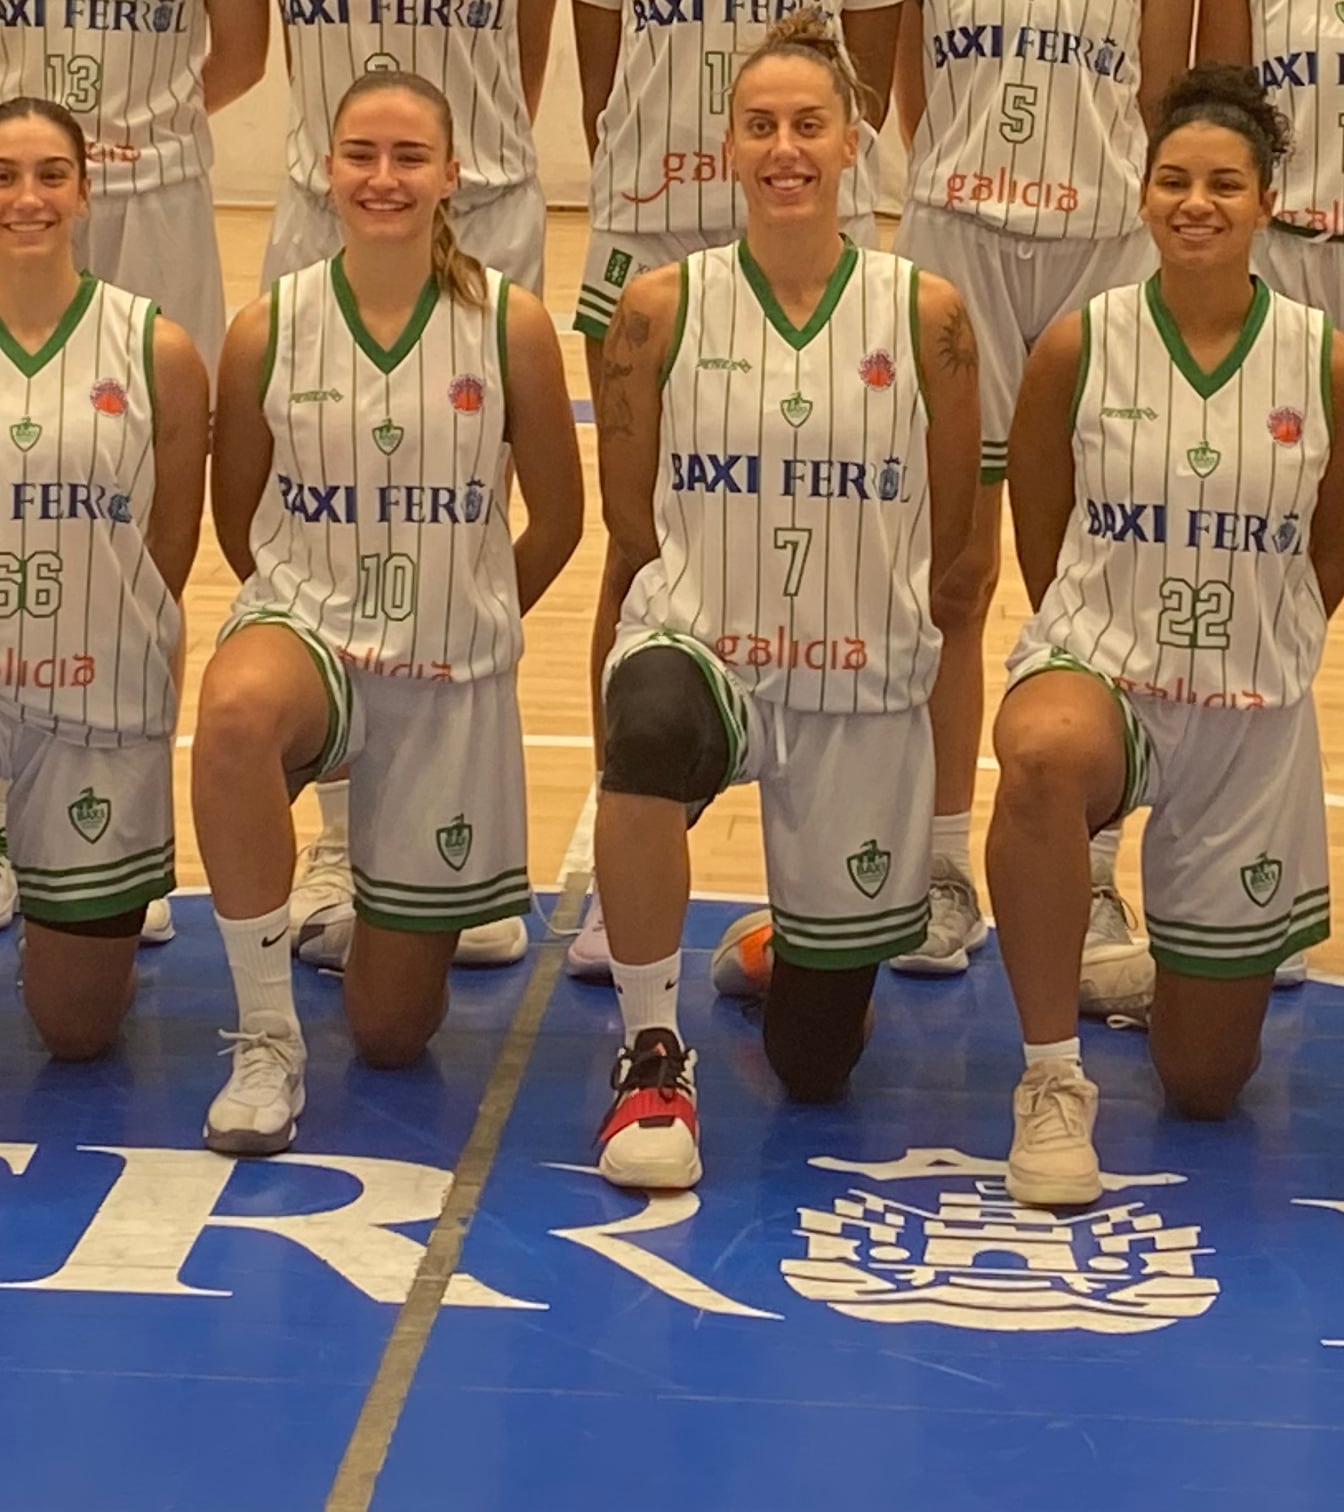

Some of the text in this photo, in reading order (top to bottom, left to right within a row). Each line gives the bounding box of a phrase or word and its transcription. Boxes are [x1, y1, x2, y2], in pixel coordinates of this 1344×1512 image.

[47, 54, 101, 114] 13
[999, 82, 1038, 145] 5
[946, 166, 1080, 214] galicia
[670, 452, 760, 495] BAXI
[1086, 498, 1167, 544] BAXI
[360, 552, 416, 622] 10
[773, 526, 813, 598] 7
[1157, 577, 1235, 651] 22
[715, 625, 868, 672] galicia
